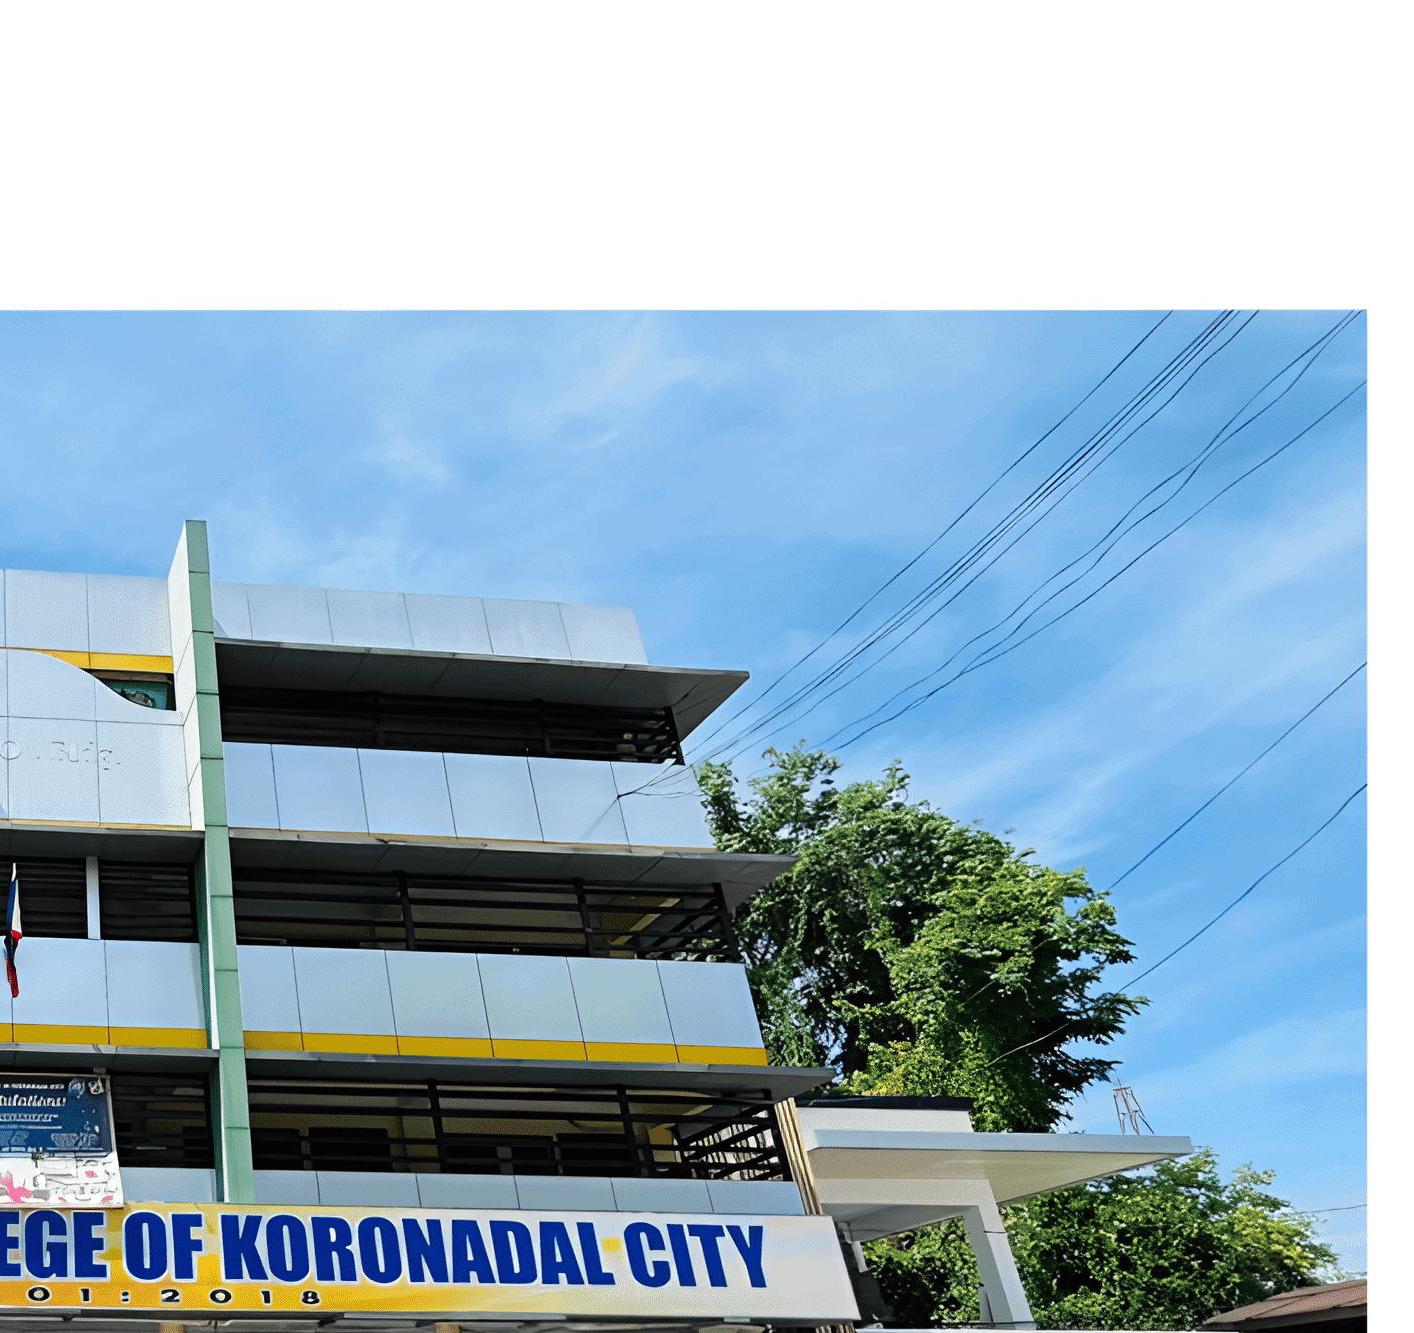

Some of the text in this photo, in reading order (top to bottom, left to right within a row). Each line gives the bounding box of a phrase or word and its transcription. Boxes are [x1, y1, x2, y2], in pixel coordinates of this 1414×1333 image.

[125, 1211, 203, 1281] OF
[221, 1214, 615, 1286] KORONADAL
[624, 1222, 766, 1288] CITY
